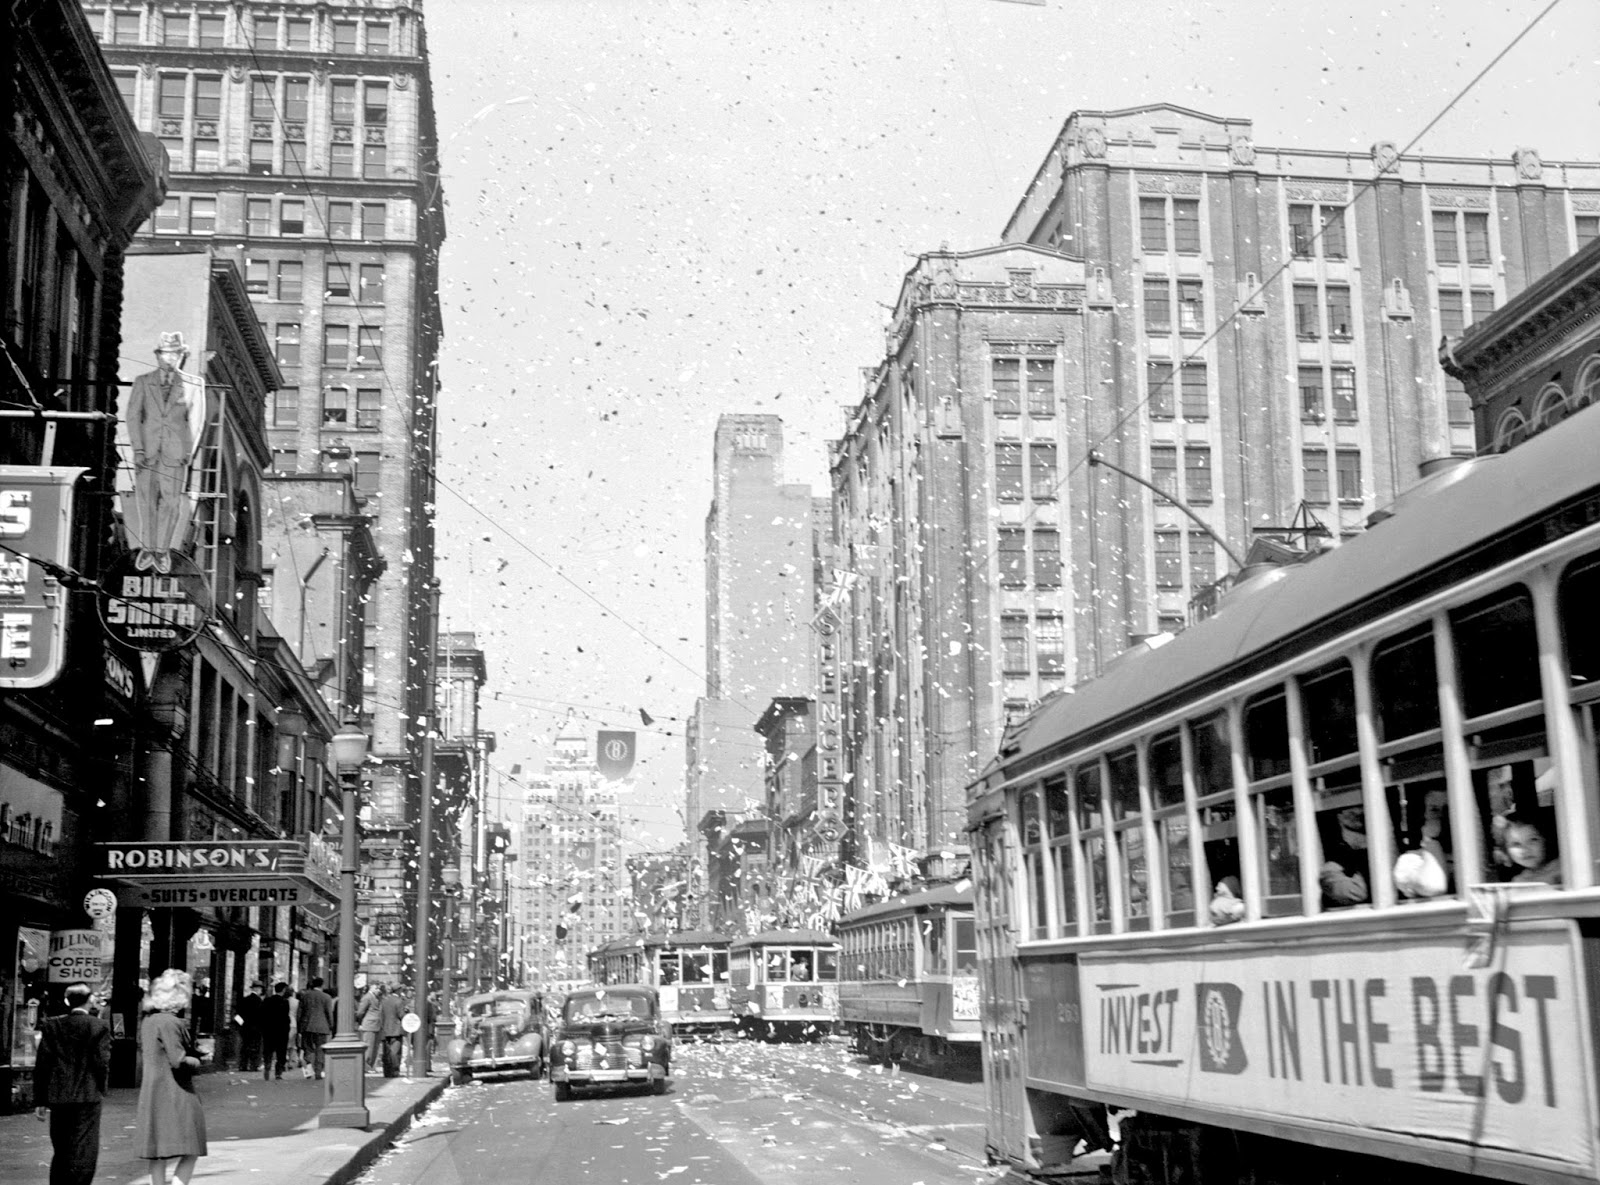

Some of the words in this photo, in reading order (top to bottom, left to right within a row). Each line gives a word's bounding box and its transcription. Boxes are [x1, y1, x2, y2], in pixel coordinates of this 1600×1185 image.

[122, 575, 186, 598] BILL
[107, 598, 195, 625] SMITH
[126, 626, 177, 638] LIMITED
[108, 848, 270, 869] ROBINSON'S
[151, 888, 198, 902] SUITS
[209, 887, 298, 902] OVERCOATS
[59, 968, 99, 978] SHOP
[1100, 988, 1179, 1054] INVEST
[1262, 980, 1303, 1081] IN
[1310, 978, 1394, 1088] THE
[1411, 971, 1557, 1108] BEST
